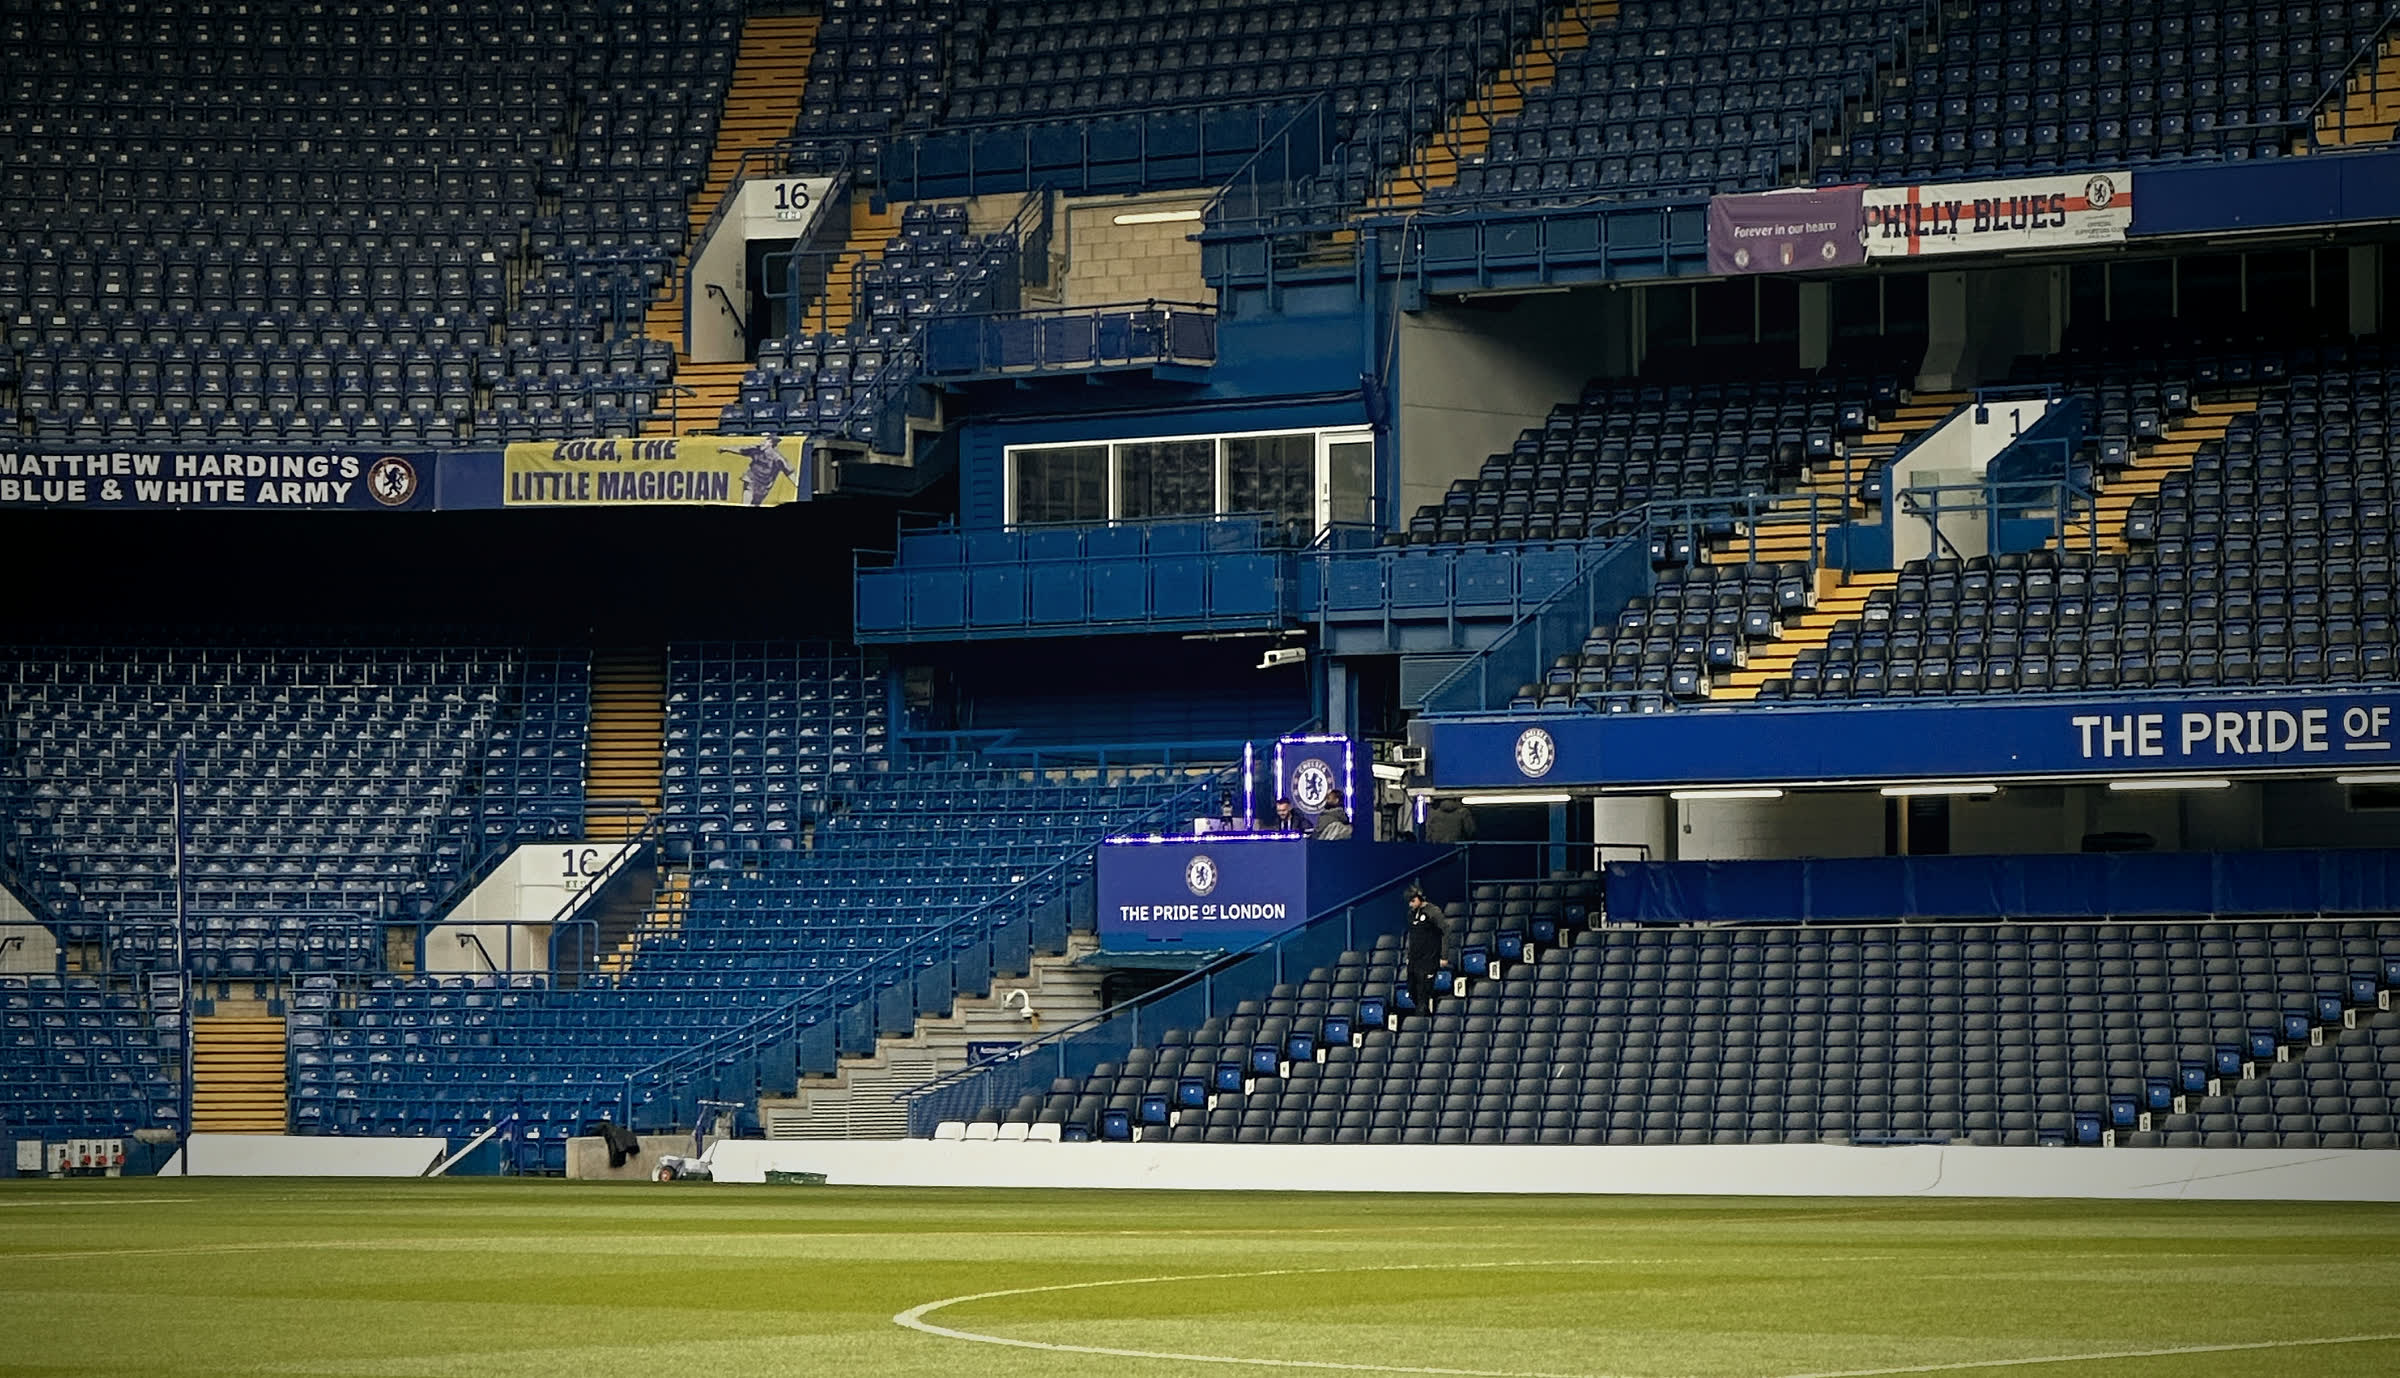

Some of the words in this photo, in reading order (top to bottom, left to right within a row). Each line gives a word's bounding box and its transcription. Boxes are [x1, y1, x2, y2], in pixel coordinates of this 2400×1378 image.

[774, 182, 811, 210] 16
[1864, 200, 1962, 239] PHILLY
[1973, 193, 2066, 233] BLUES
[1734, 225, 1773, 238] Forever
[1775, 223, 1785, 236] in
[1787, 224, 1804, 235] our
[553, 440, 623, 463] ZOLA,
[631, 439, 680, 461] THE
[0, 453, 160, 477] MATTHEW
[175, 455, 360, 478] HARDING'S
[1, 479, 87, 502] BLUE
[100, 479, 123, 500] &
[134, 480, 246, 503] WHITE
[255, 481, 353, 504] ARMY
[511, 471, 590, 501] LITTLE
[597, 470, 729, 501] MAGICIAN
[2072, 714, 2164, 758] THE
[2181, 709, 2329, 755] PRIDE
[2343, 707, 2391, 739] OF
[1120, 906, 1149, 921] THE
[1153, 905, 1199, 921] PRIDE
[1202, 904, 1217, 917] OF
[1220, 903, 1286, 920] LONDON
[1525, 947, 1532, 961] S
